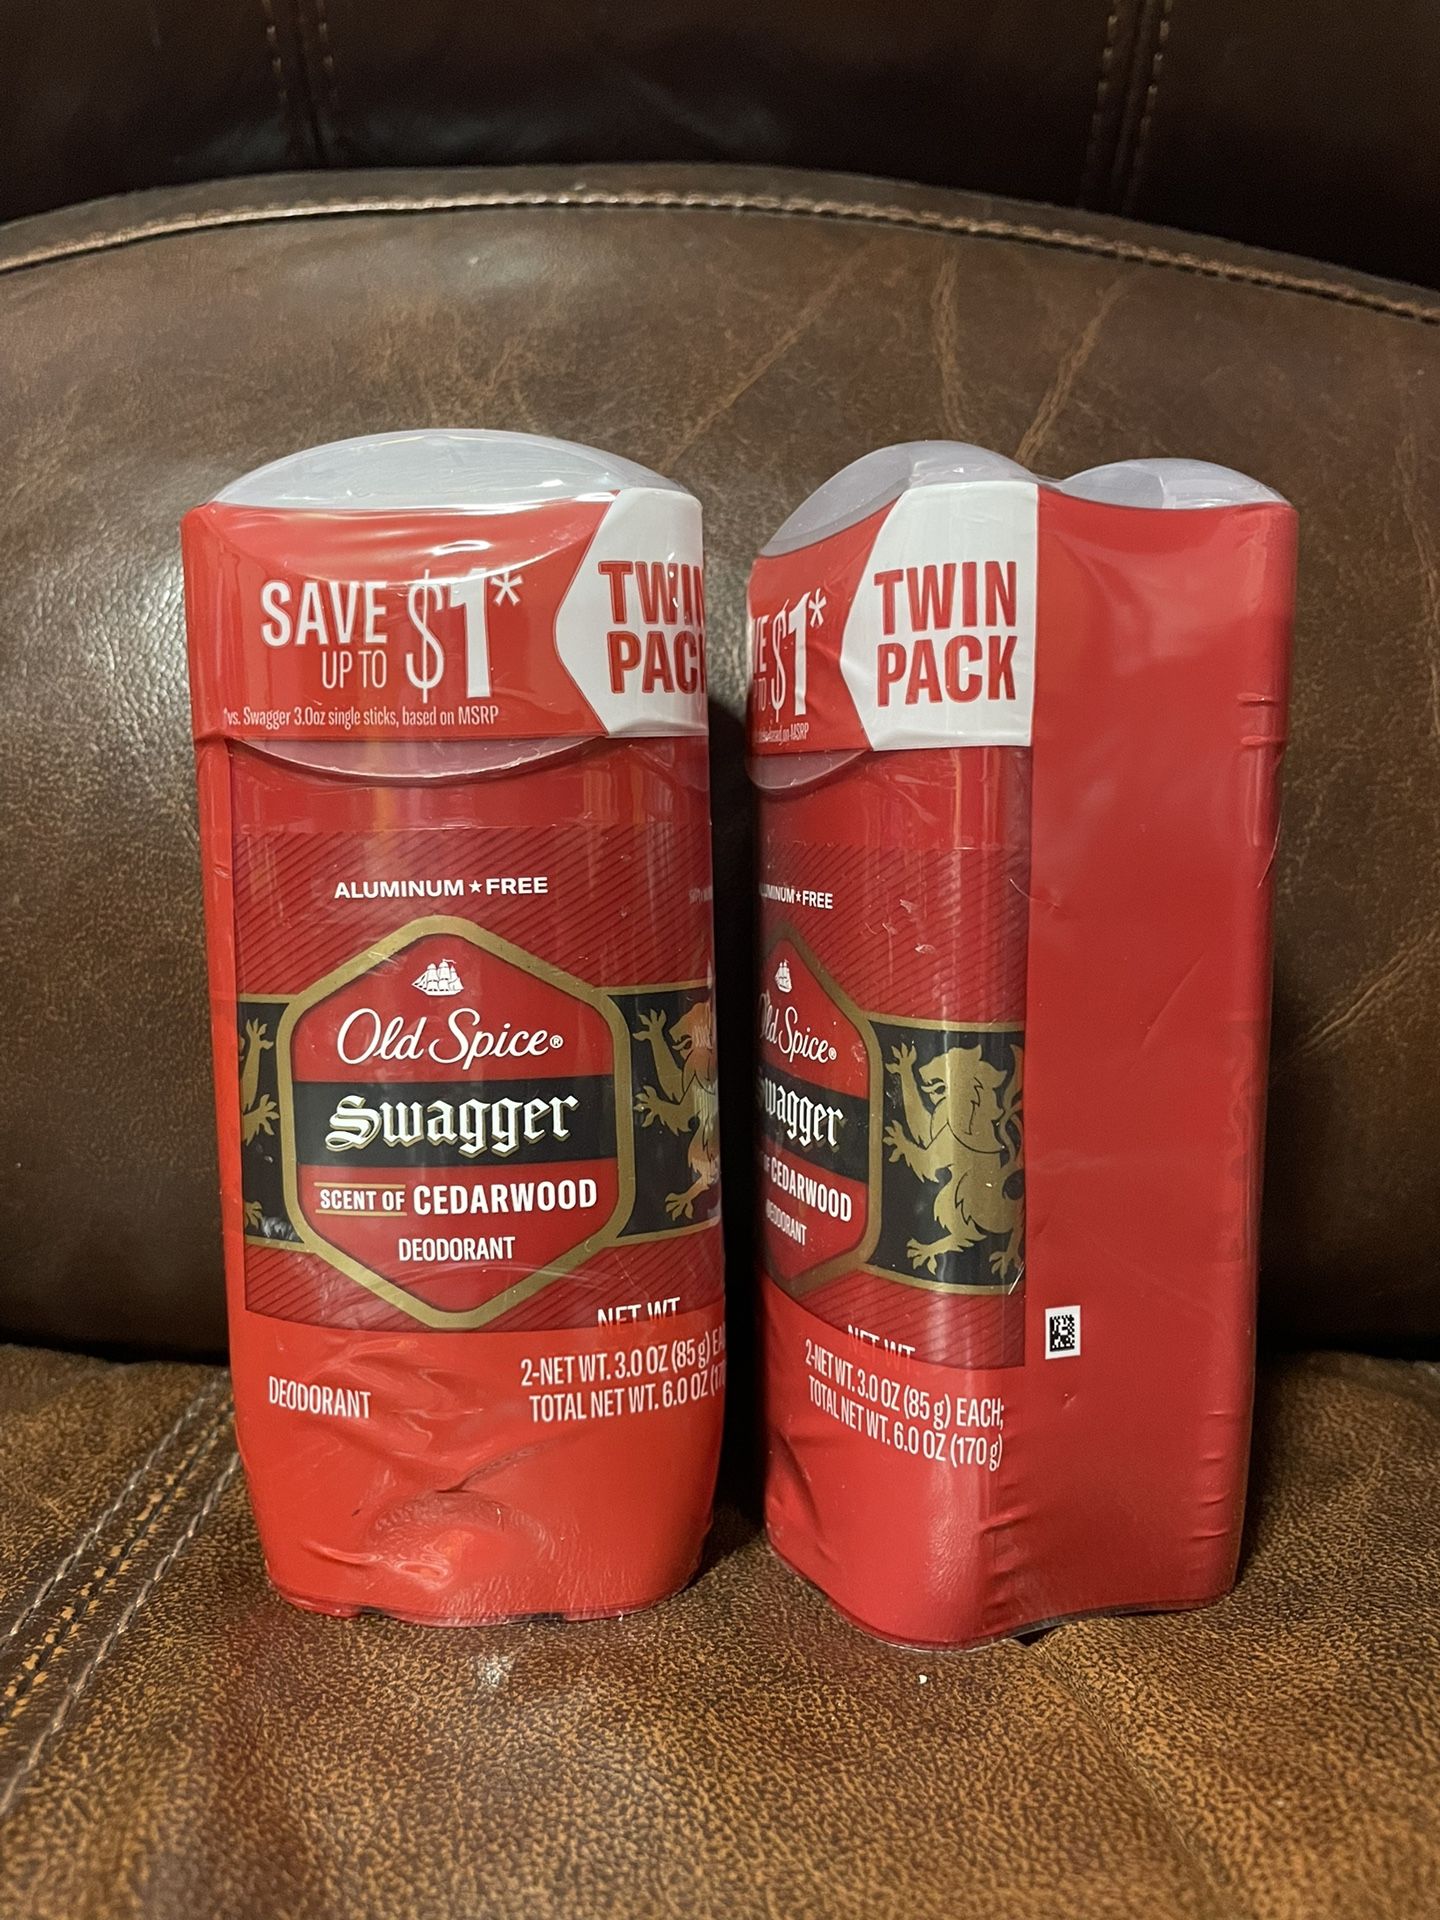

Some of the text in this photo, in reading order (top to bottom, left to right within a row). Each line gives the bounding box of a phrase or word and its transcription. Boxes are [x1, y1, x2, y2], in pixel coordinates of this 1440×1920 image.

[261, 580, 388, 647] SAVE
[873, 561, 1017, 636] TWIN
[321, 650, 387, 689] UP TO
[876, 634, 1018, 708] PACK
[243, 707, 291, 730] Swagger
[293, 706, 326, 726] 3.0oz
[327, 707, 361, 730] single
[363, 706, 399, 727] sticks,
[402, 706, 436, 726] based
[440, 711, 455, 725] on
[458, 705, 499, 725] MSRP
[334, 876, 549, 899] ALUMINUM FREE
[802, 889, 833, 910] FREE
[336, 1008, 430, 1065] Old
[325, 1095, 580, 1159] Swagger
[763, 1077, 845, 1148] wagger
[320, 1179, 598, 1216] SCENT OF CEDARWOOD
[771, 1156, 852, 1223] CEDARWOOD
[398, 1237, 516, 1263] DEODORANT
[520, 1355, 577, 1387] 2-NET
[578, 1353, 612, 1384] WT.
[614, 1348, 643, 1379] 3.0
[645, 1344, 669, 1375] OZ
[671, 1339, 696, 1374] (85
[697, 1330, 711, 1369] g)
[805, 1338, 834, 1379] 2-NET
[834, 1355, 856, 1393] WT.
[857, 1368, 879, 1403] 3.0
[880, 1378, 901, 1412] OZ
[903, 1384, 931, 1421] (85
[933, 1393, 951, 1431] g)
[268, 1376, 371, 1419] DEODORANT
[529, 1393, 587, 1423] TOTAL
[590, 1387, 625, 1419] NET
[628, 1382, 659, 1414] WT.
[662, 1376, 688, 1408] 6.0
[690, 1369, 709, 1401] OZ
[808, 1374, 1003, 1472] TOTAL NET WT. 6.0 OZ (170 g)
